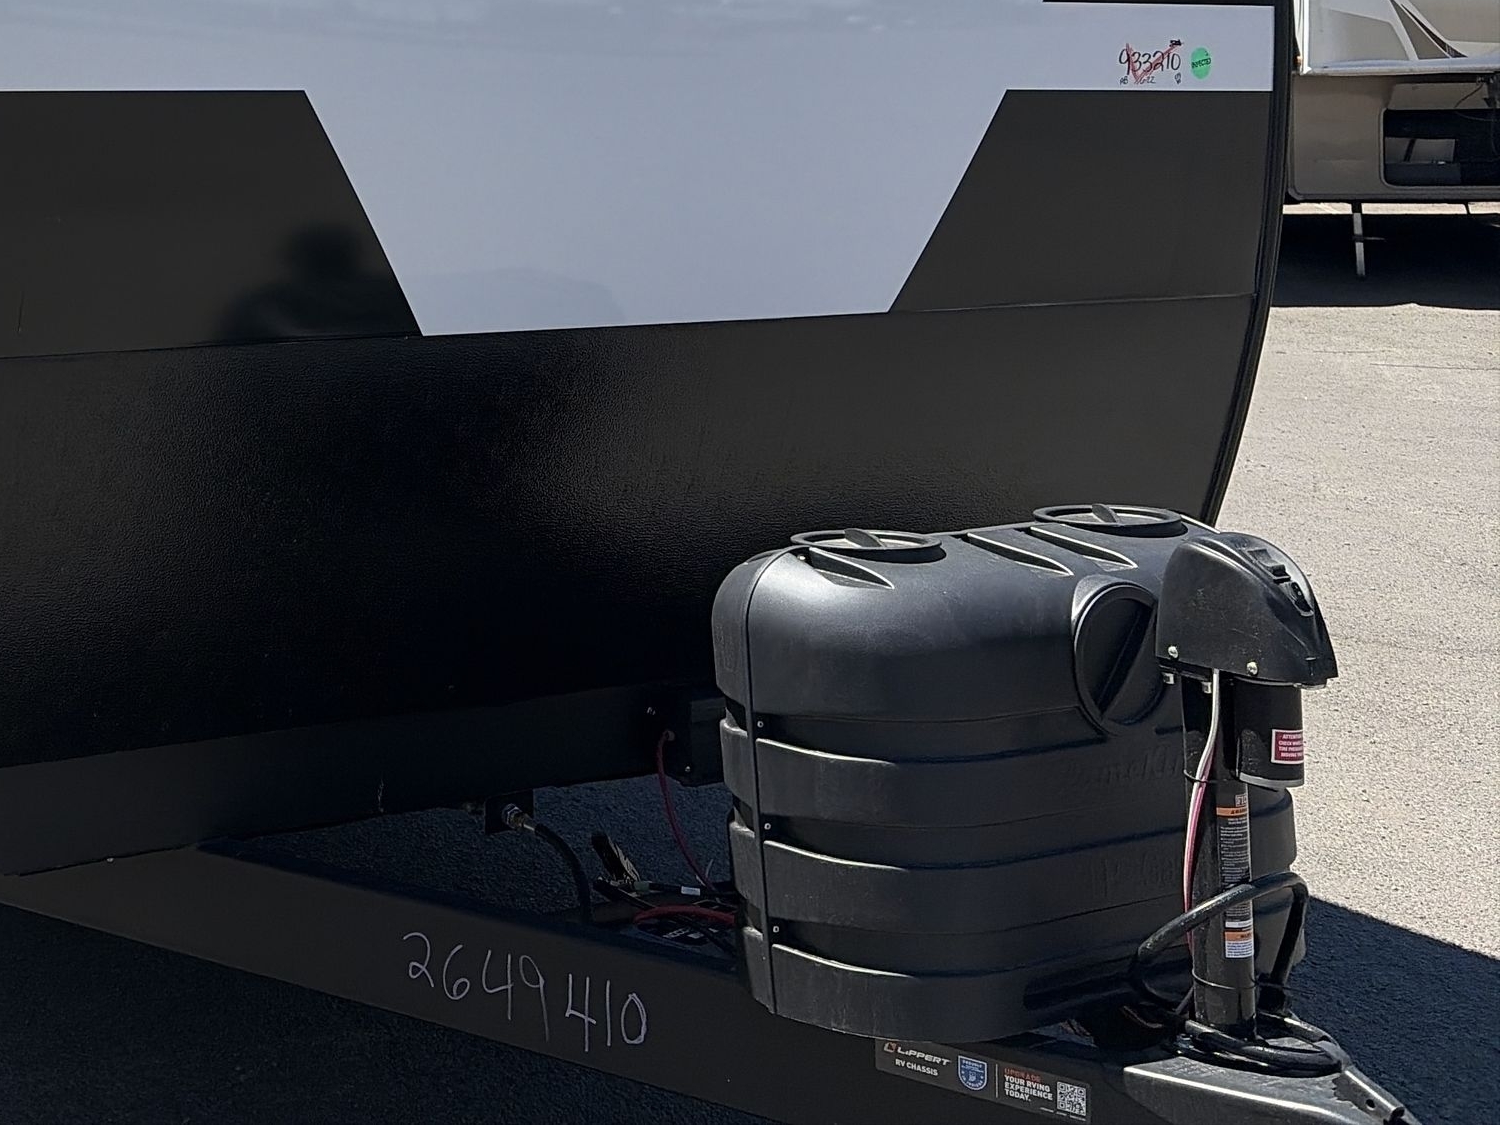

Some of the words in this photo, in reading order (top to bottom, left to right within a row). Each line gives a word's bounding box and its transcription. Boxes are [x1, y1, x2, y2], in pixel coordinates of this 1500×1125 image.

[906, 1062, 938, 1076] CHASSIS
[1004, 1074, 1025, 1086] YOUR
[1004, 1082, 1053, 1100] EXPERIENCE
